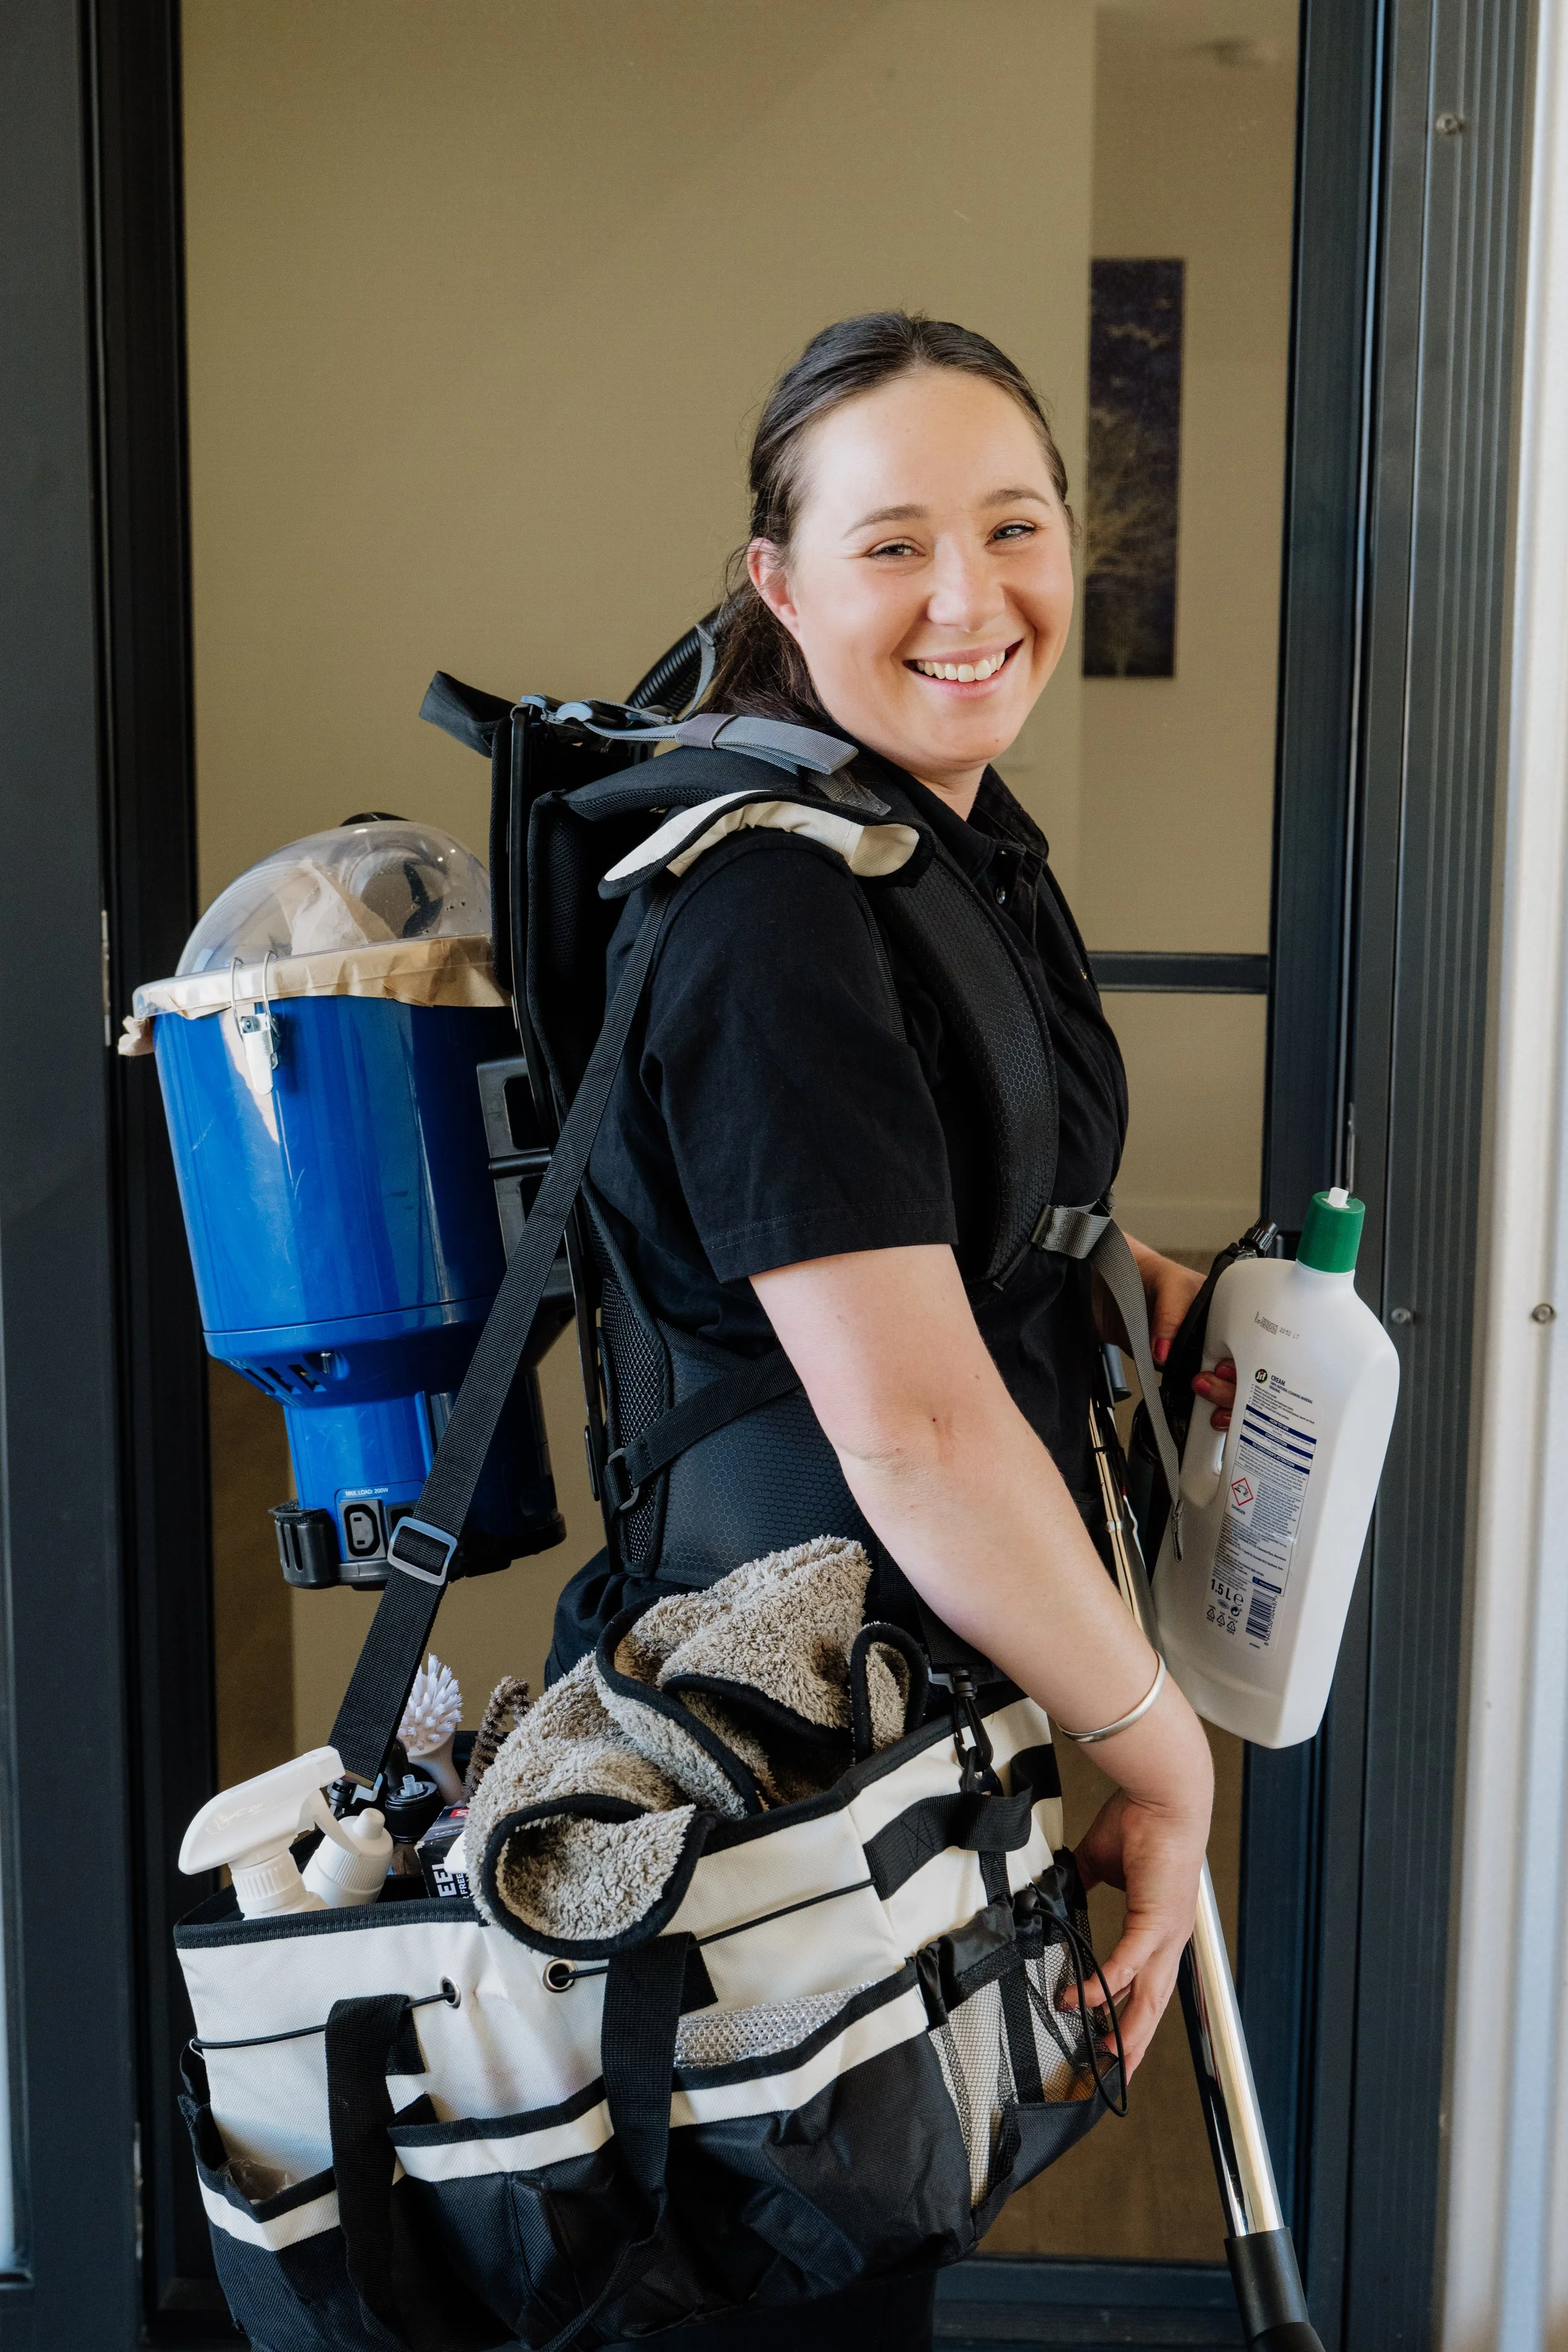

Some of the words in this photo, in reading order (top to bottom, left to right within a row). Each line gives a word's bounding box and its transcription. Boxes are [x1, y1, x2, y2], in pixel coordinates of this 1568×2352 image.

[1256, 1370, 1267, 1380] Jif
[1271, 1375, 1285, 1386] CREAM
[1269, 1385, 1281, 1394] ORIGINAL
[1277, 1384, 1288, 1392] NATURAL
[1288, 1390, 1301, 1399] CLEANING
[1301, 1396, 1313, 1404] MINERAL
[1265, 1433, 1288, 1447] COMPOSITION
[1276, 1454, 1295, 1467] ATTENTION
[1231, 1504, 1246, 1515] DANGER
[1211, 1579, 1224, 1595] 1.5
[1226, 1587, 1231, 1601] L
[1259, 1581, 1280, 1592] PROFESSIONAL
[456, 1873, 469, 1895] FREE
